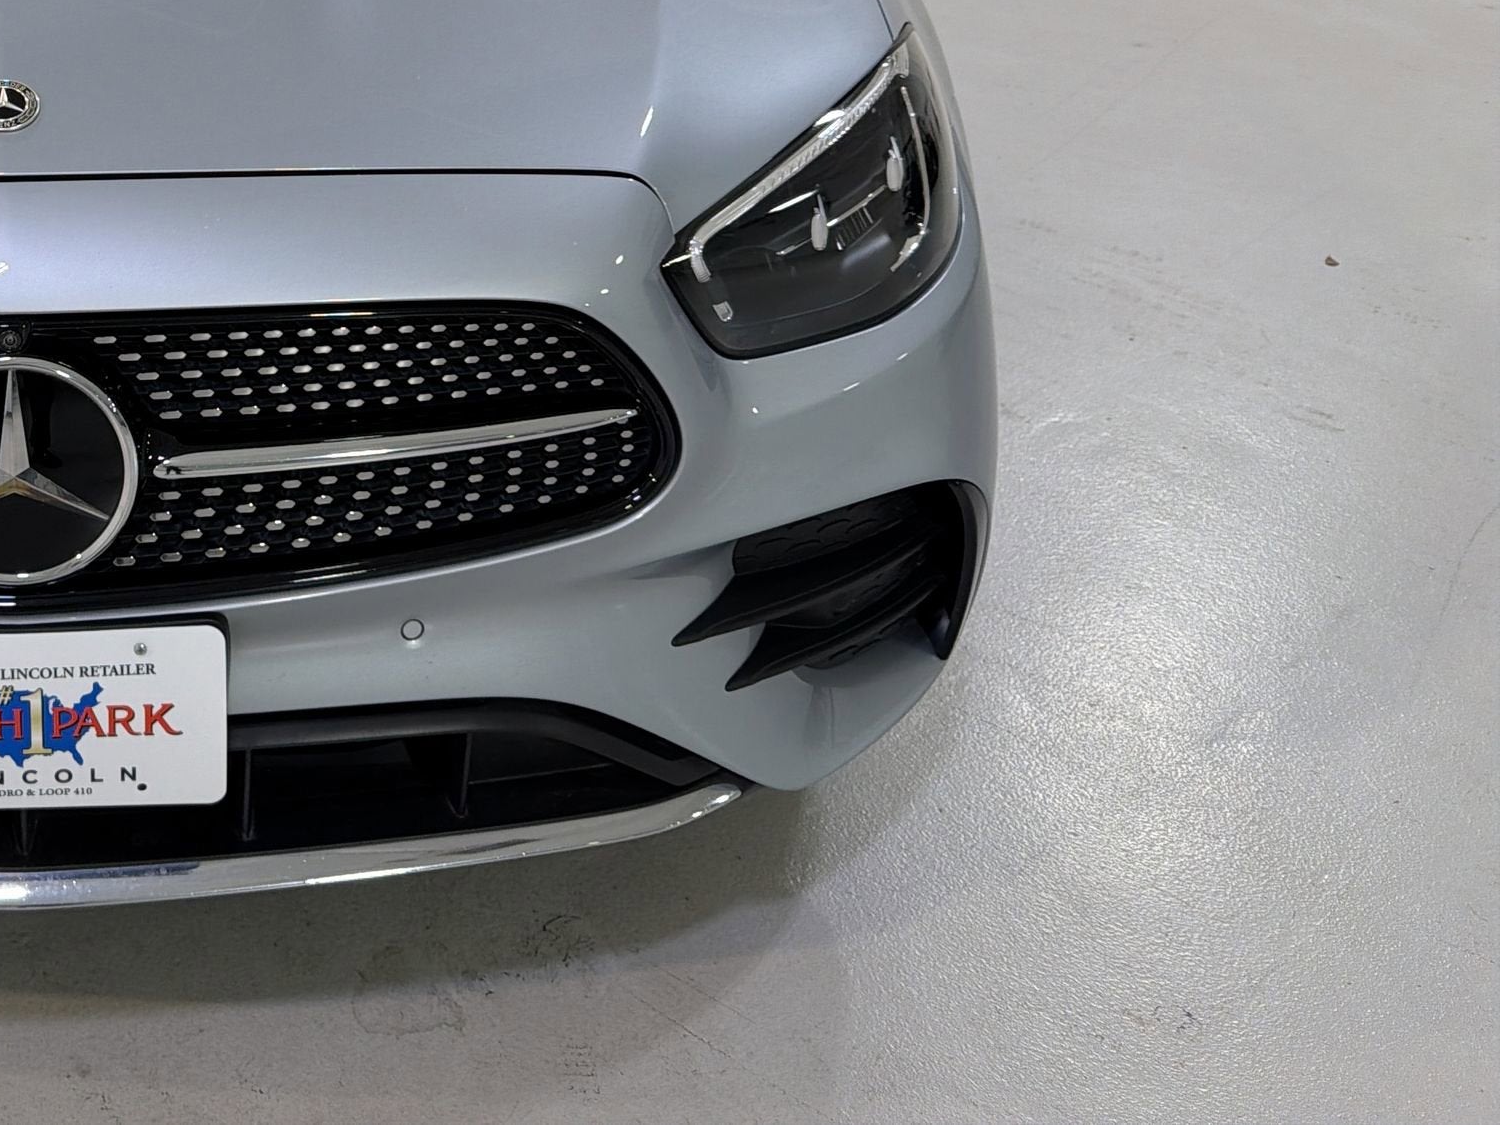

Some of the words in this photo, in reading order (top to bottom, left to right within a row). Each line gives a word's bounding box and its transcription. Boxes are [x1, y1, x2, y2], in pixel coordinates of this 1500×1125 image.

[0, 666, 75, 680] LINCOLN
[79, 663, 156, 679] RETAILER
[51, 703, 183, 738] PARK
[26, 789, 36, 797] &
[39, 787, 70, 796] LOOP
[74, 787, 93, 795] 410
